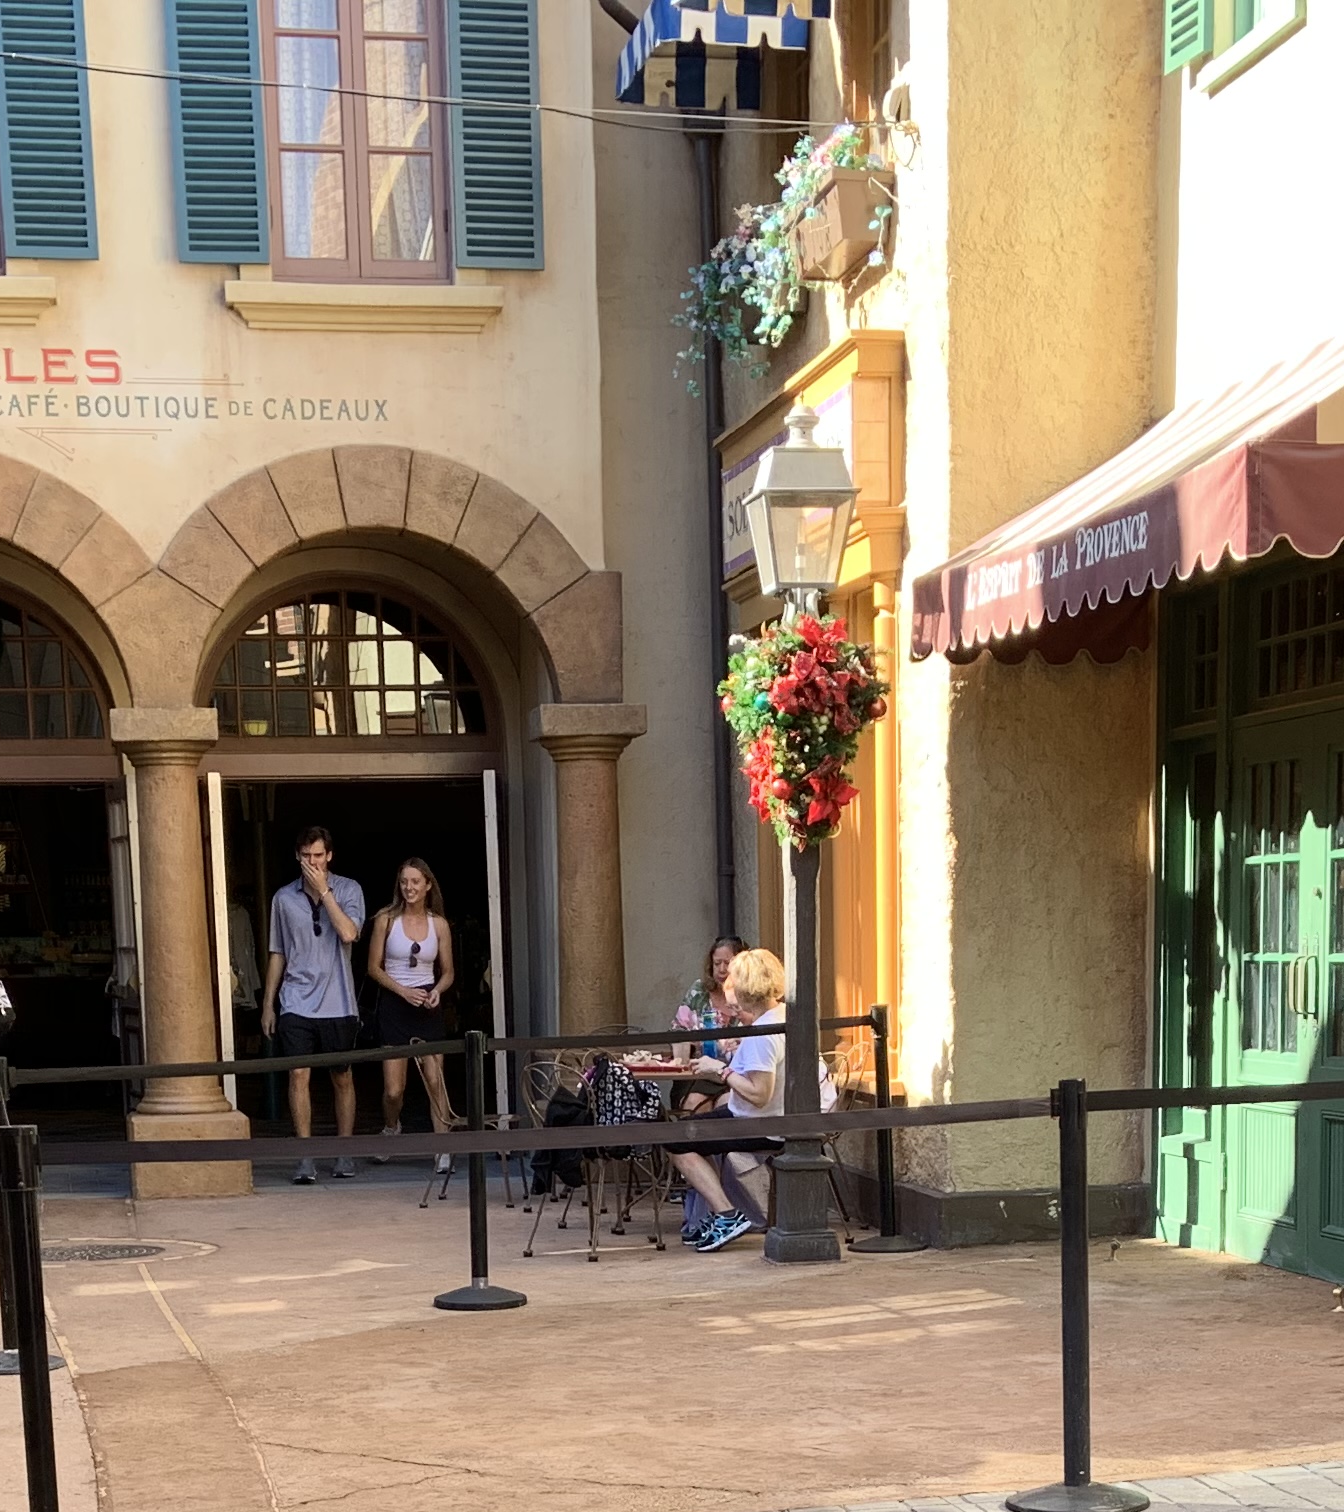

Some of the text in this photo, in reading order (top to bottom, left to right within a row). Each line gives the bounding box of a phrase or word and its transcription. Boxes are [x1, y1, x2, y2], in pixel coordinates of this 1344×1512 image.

[76, 395, 219, 421] BOUTIQUE
[229, 401, 254, 418] DE
[262, 397, 389, 422] CADEAUX
[965, 511, 1149, 611] L'ESPRIT DE LA PROVENCE
